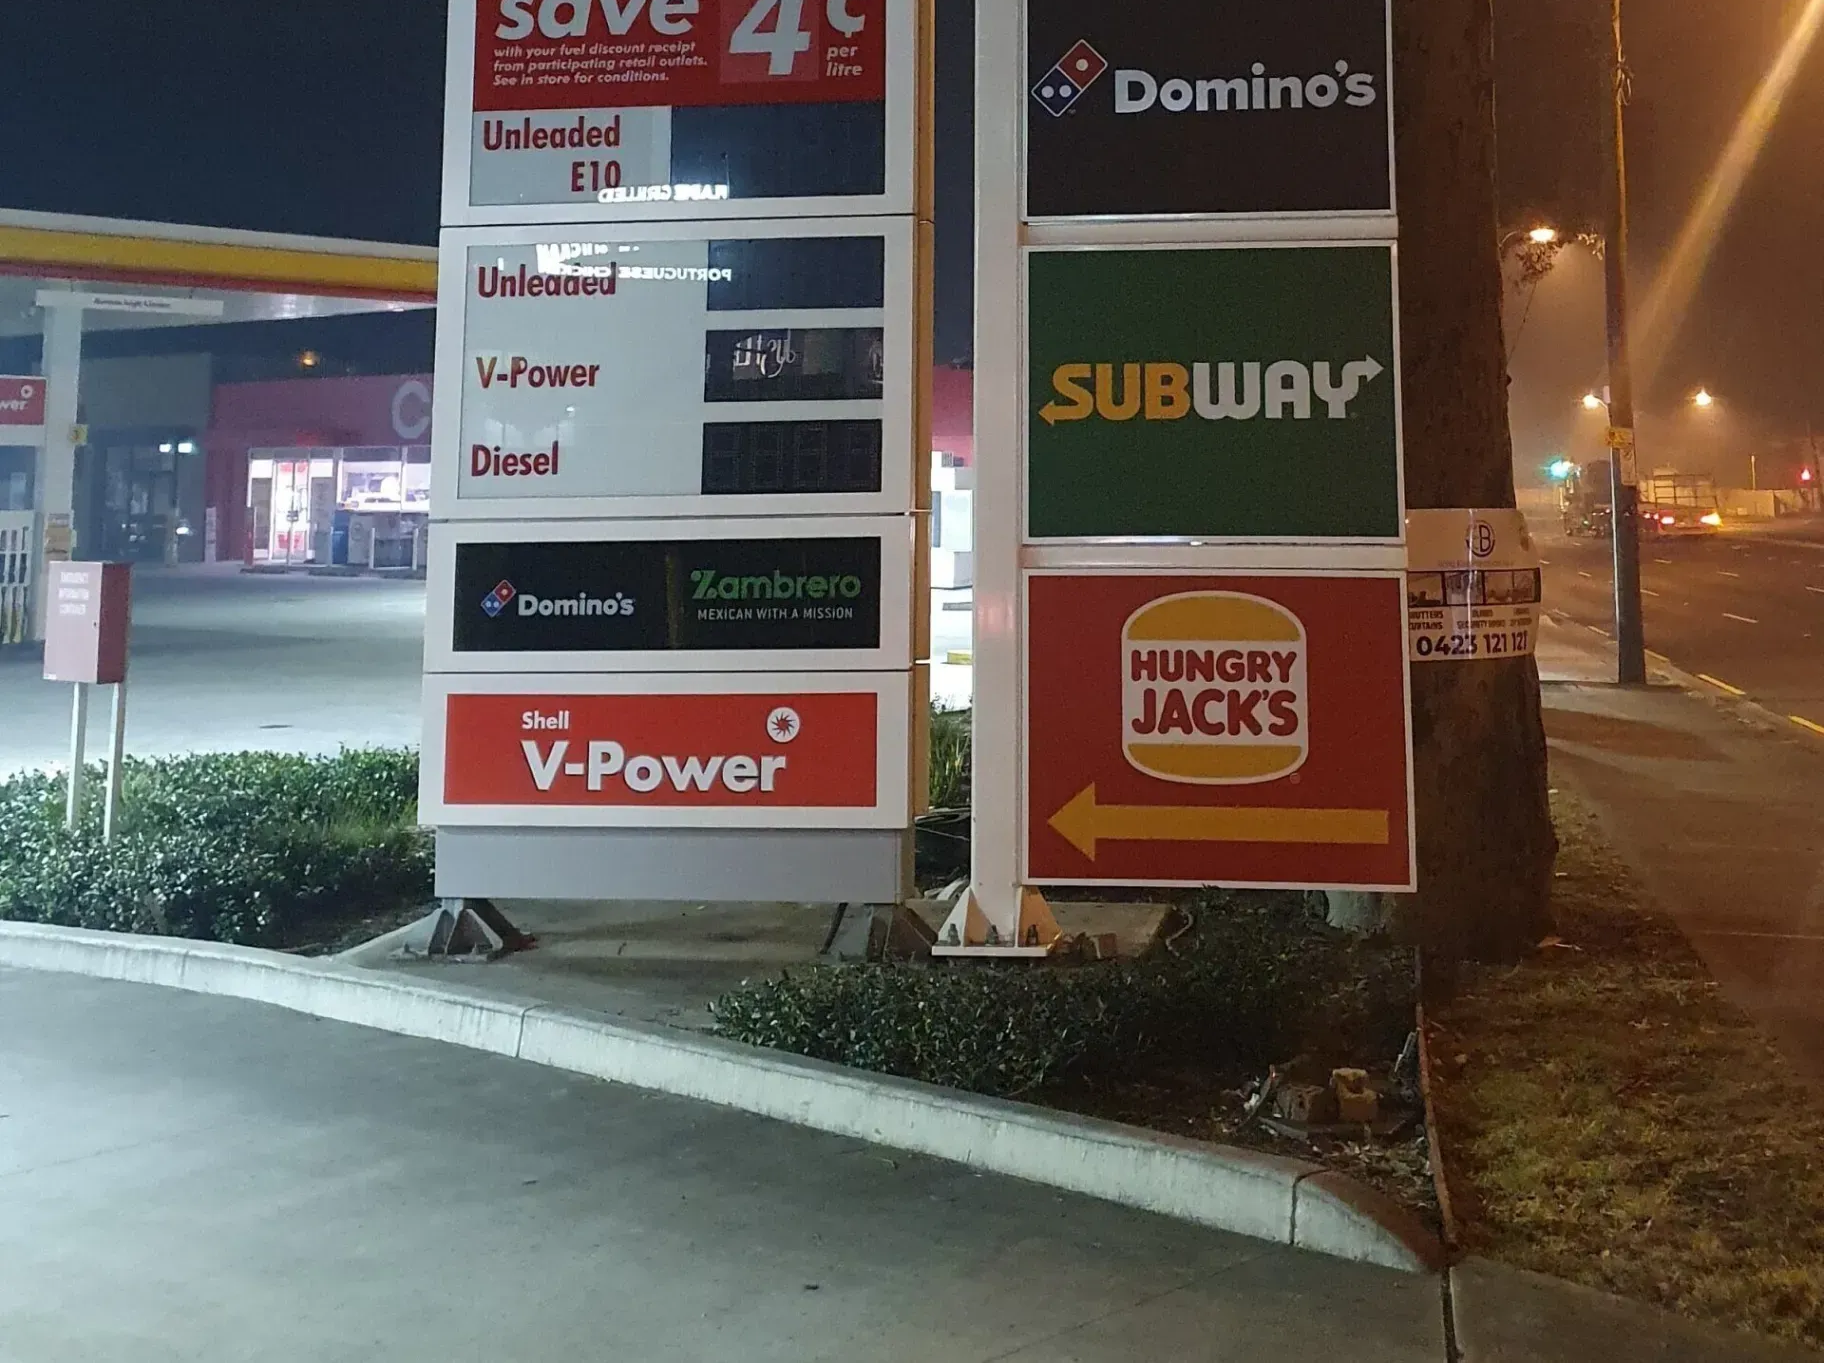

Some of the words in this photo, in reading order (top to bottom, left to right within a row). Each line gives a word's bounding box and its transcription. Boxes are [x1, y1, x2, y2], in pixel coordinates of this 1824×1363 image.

[494, 44, 522, 57] with
[526, 47, 556, 59] your
[560, 43, 585, 56] fuel
[589, 43, 645, 55] discount
[649, 41, 696, 55] receipt
[494, 60, 524, 72] from
[528, 57, 615, 73] participating
[619, 55, 656, 68] retail
[826, 46, 858, 61] per
[493, 74, 517, 86] See
[520, 73, 534, 85] in
[537, 73, 571, 85] store
[573, 71, 594, 84] for
[597, 70, 669, 83] conditions.
[826, 61, 863, 77] litre
[1114, 59, 1377, 114] Domino's
[482, 114, 621, 151] Unleaded
[571, 160, 621, 192] E10
[478, 262, 617, 298] Unleaded
[476, 356, 600, 390] V-Power
[1038, 354, 1384, 427] SUBWAY
[471, 441, 559, 477] Diesel
[690, 569, 861, 600] Zambrero
[518, 591, 635, 616] Domino's
[697, 608, 752, 620] MEXICAN
[756, 608, 787, 620] WITH
[790, 608, 799, 619] A
[803, 607, 853, 619] MISSION
[1416, 634, 1477, 657] 0423
[1483, 632, 1507, 654] 121
[1130, 649, 1298, 684] HUNGRY
[522, 710, 570, 730] Shell
[1131, 688, 1299, 736] JACK'S
[520, 739, 786, 793] V-Power
